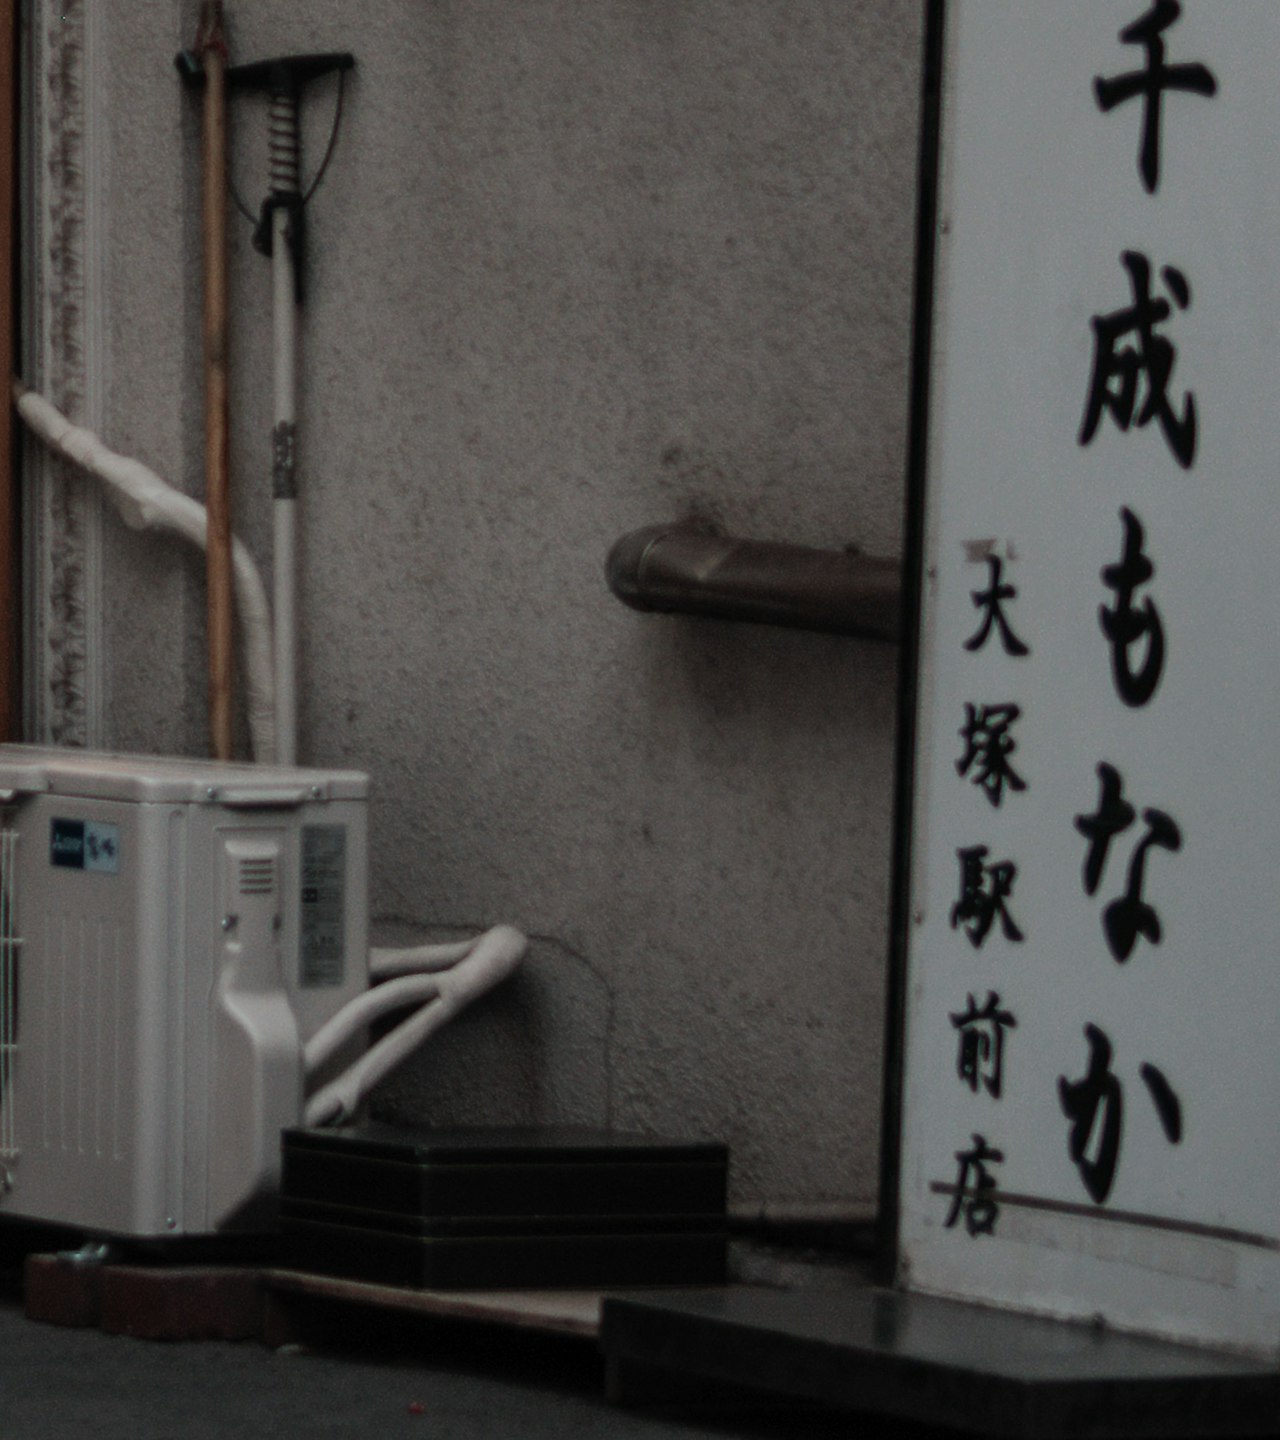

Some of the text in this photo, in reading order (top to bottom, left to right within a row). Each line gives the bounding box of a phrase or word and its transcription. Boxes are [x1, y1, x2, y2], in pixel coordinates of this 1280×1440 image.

[944, 552, 1030, 1240] 大塚駅前店
